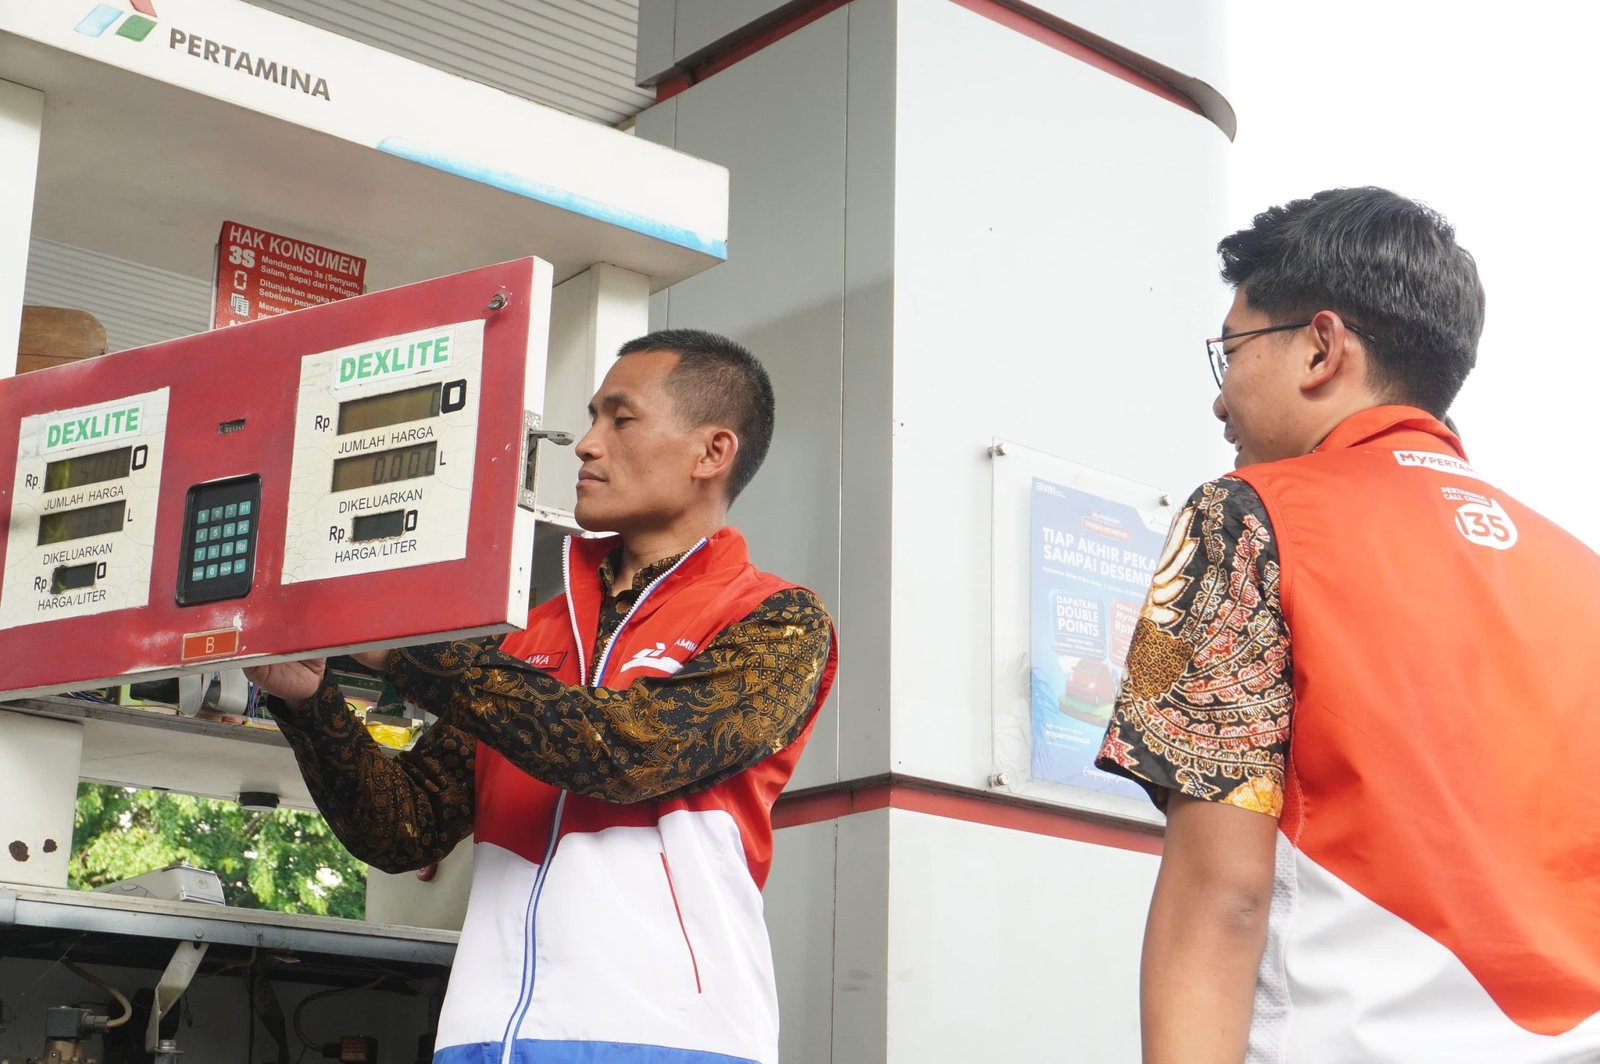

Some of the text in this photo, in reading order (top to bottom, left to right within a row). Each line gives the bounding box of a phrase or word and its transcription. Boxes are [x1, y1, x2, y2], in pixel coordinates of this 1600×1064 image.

[169, 27, 331, 101] PERTAMINA
[228, 245, 256, 268] 3S
[229, 225, 361, 277] HAK KONSUMEN
[261, 255, 313, 276] Mendapatkan
[260, 265, 287, 280] Salam,
[288, 273, 311, 287] Sapa)
[312, 280, 328, 290] dari
[260, 278, 306, 298] Ditunjukkan
[259, 288, 293, 304] Sebelum
[339, 336, 450, 383] DEXLITE
[440, 378, 467, 415] 0
[47, 407, 140, 448] DEXLITE
[338, 426, 434, 454] JUMLAH HARGA
[131, 444, 149, 471] 0
[439, 451, 446, 466] L
[44, 485, 124, 511] JUMLAH HARGA
[338, 488, 423, 514] DIKELUARKAN
[127, 508, 133, 522] L
[404, 509, 418, 532] 0
[213, 529, 218, 537] 5
[226, 526, 232, 534] 6
[1456, 512, 1510, 542] 135
[42, 543, 113, 565] DIKELUARKAN
[225, 545, 230, 553] 9
[334, 539, 417, 563] HARGA/LITER
[1042, 527, 1074, 547] TIAP
[1077, 538, 1119, 562] AKHIR
[1123, 550, 1156, 571] PEKA
[97, 562, 107, 579] 0
[1043, 545, 1097, 572] SAMPAI
[1101, 561, 1152, 587] DESEMB
[38, 589, 106, 611] HARGA/LITER
[1056, 596, 1098, 610] DAPATKAN
[1056, 605, 1099, 623] DOUBLE
[1058, 618, 1099, 637] POINTS
[206, 637, 215, 653] B
[523, 655, 550, 665] AWA
